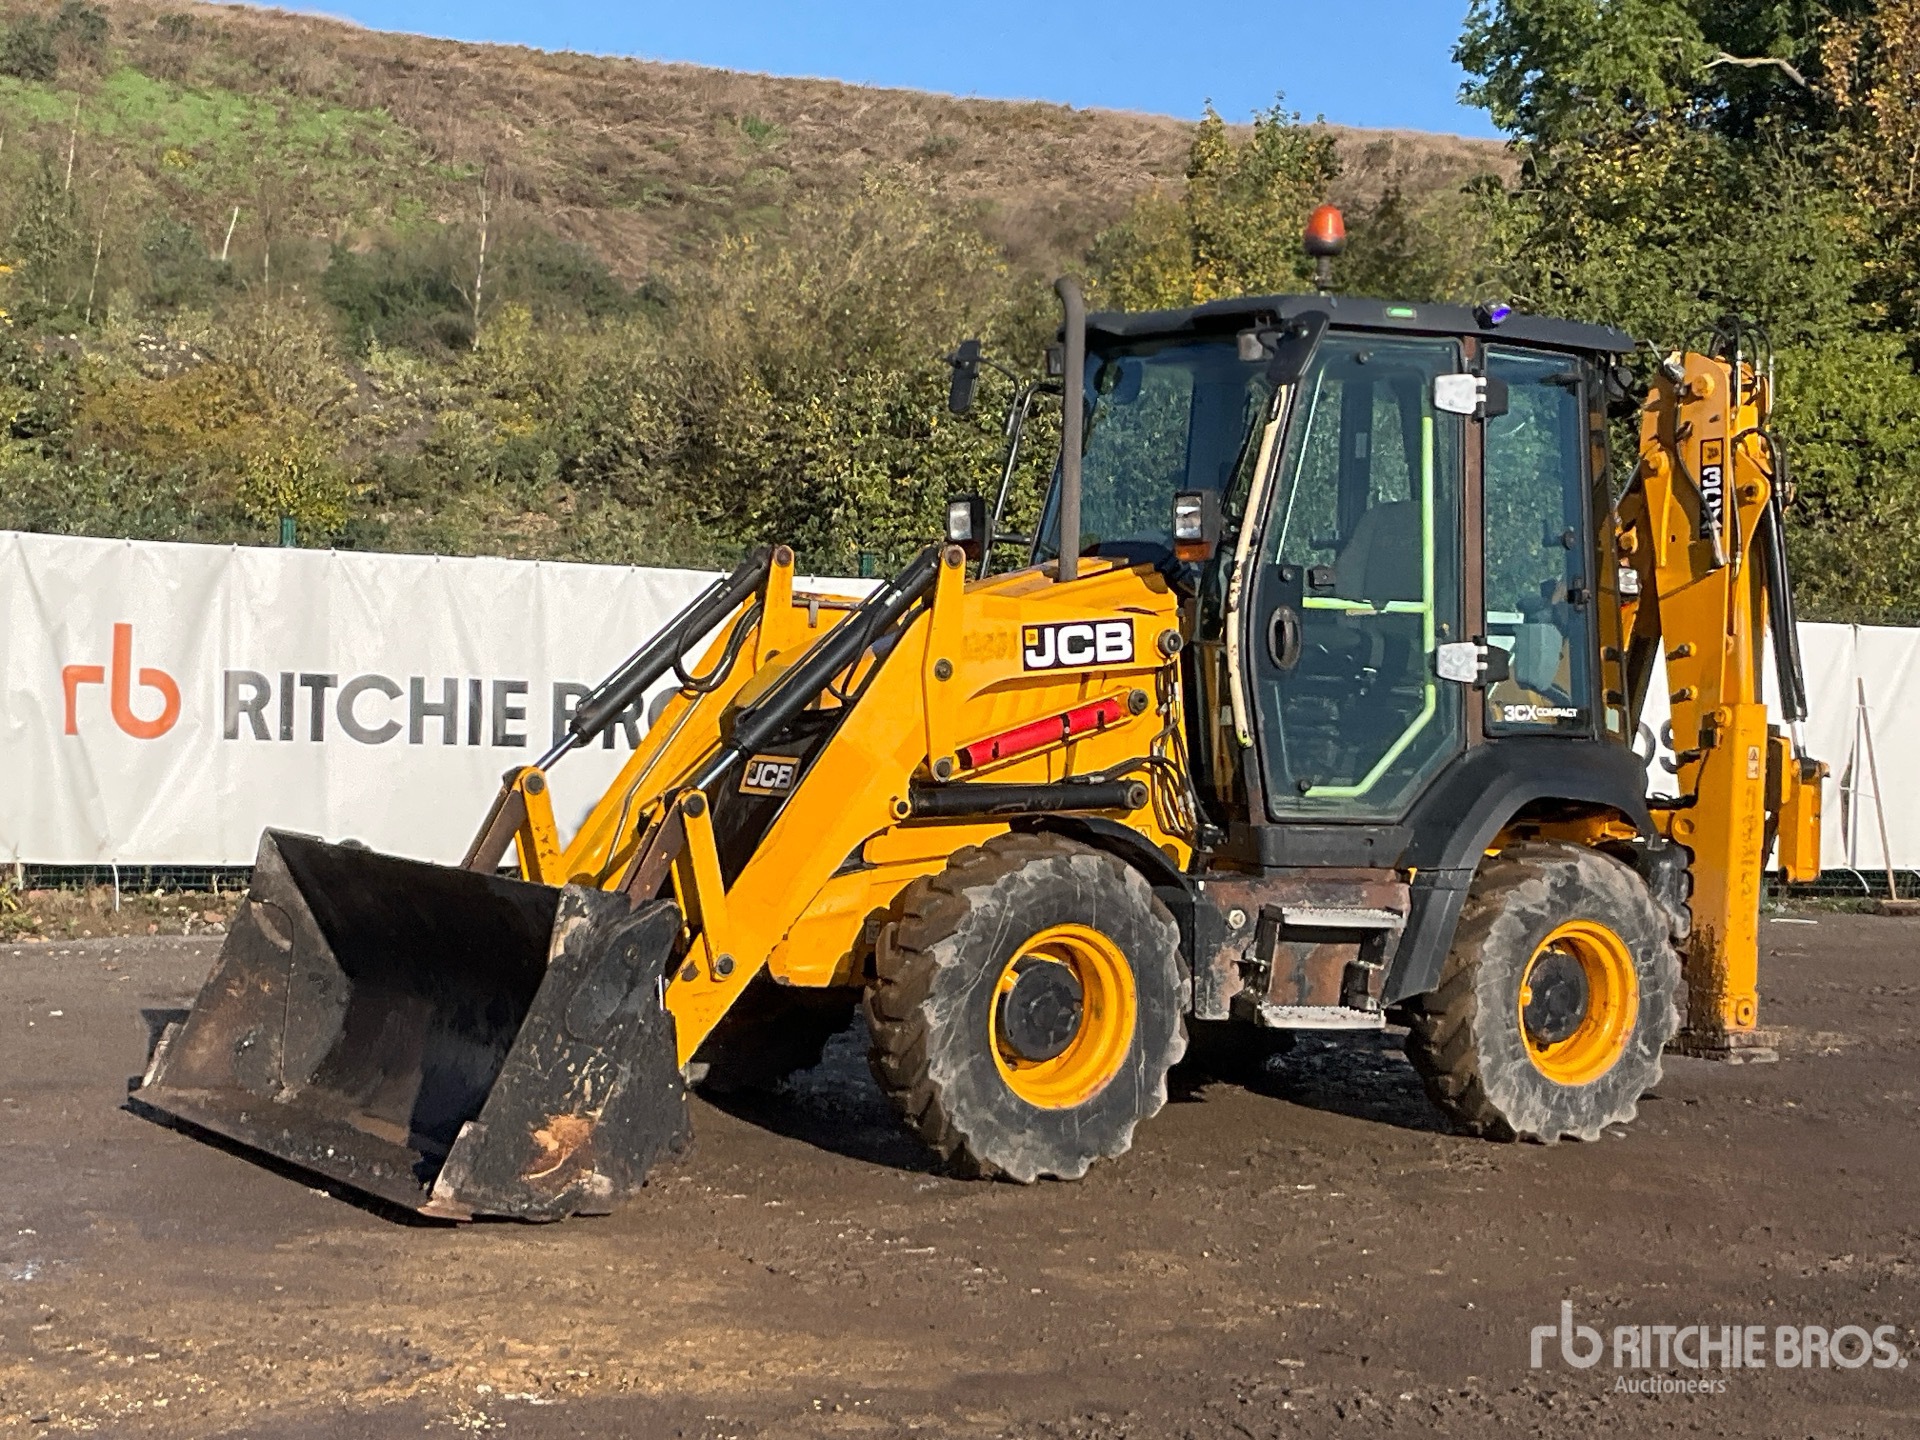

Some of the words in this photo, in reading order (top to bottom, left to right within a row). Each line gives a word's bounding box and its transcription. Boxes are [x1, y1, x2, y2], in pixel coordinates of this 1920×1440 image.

[1025, 622, 1133, 668] JCB
[224, 670, 528, 748] RITCHIE
[1504, 704, 1538, 721] 3CX
[1536, 707, 1577, 718] COMPACT
[747, 763, 793, 789] JCB
